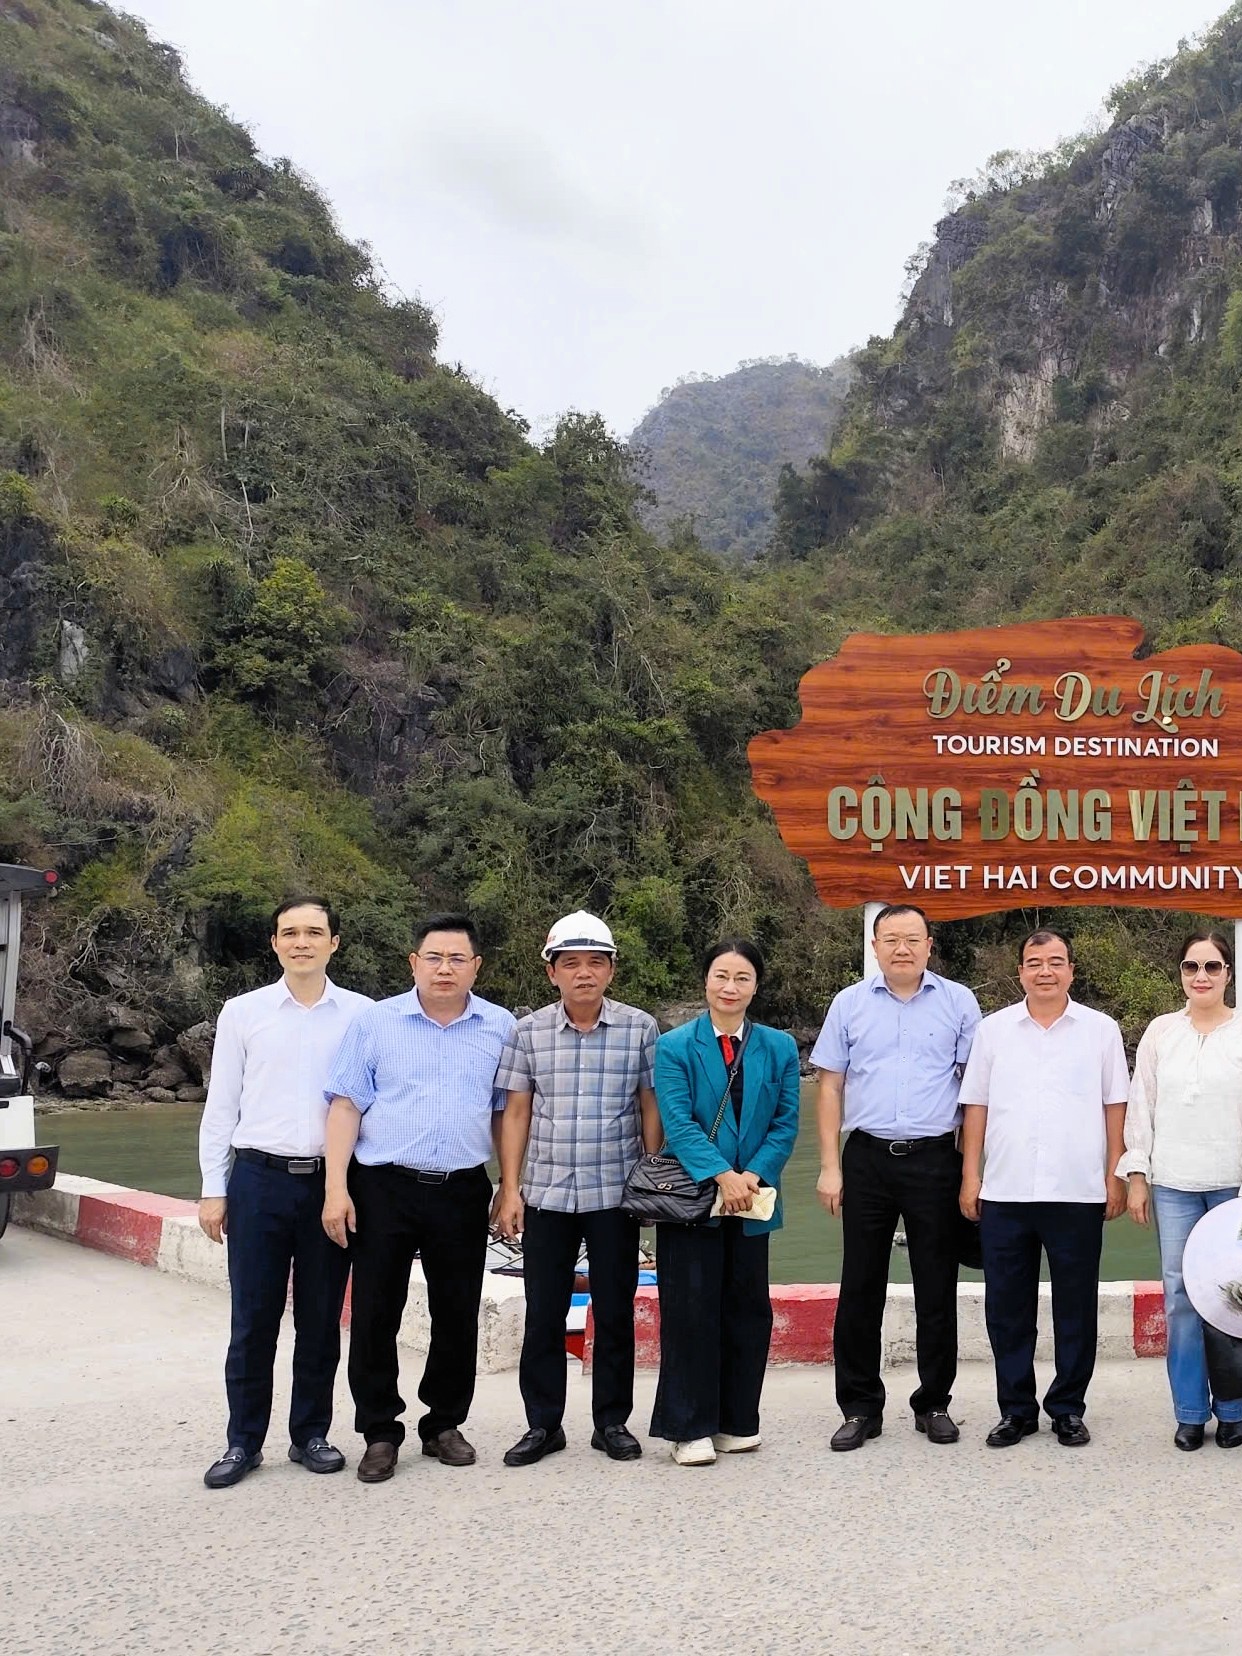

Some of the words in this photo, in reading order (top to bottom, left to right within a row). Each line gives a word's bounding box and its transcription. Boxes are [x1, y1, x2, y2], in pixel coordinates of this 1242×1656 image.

[923, 657, 1046, 719] Điểm
[1054, 671, 1125, 722] Du
[1131, 668, 1228, 734] Lịch
[932, 735, 1046, 756] TOURISM
[1054, 737, 1219, 757] DESTINATION
[827, 774, 962, 852] CỘNG
[978, 768, 1112, 842] ĐỒNG
[1128, 778, 1227, 852] VIỆT
[899, 865, 972, 890] VIET
[983, 866, 1038, 890] HAI
